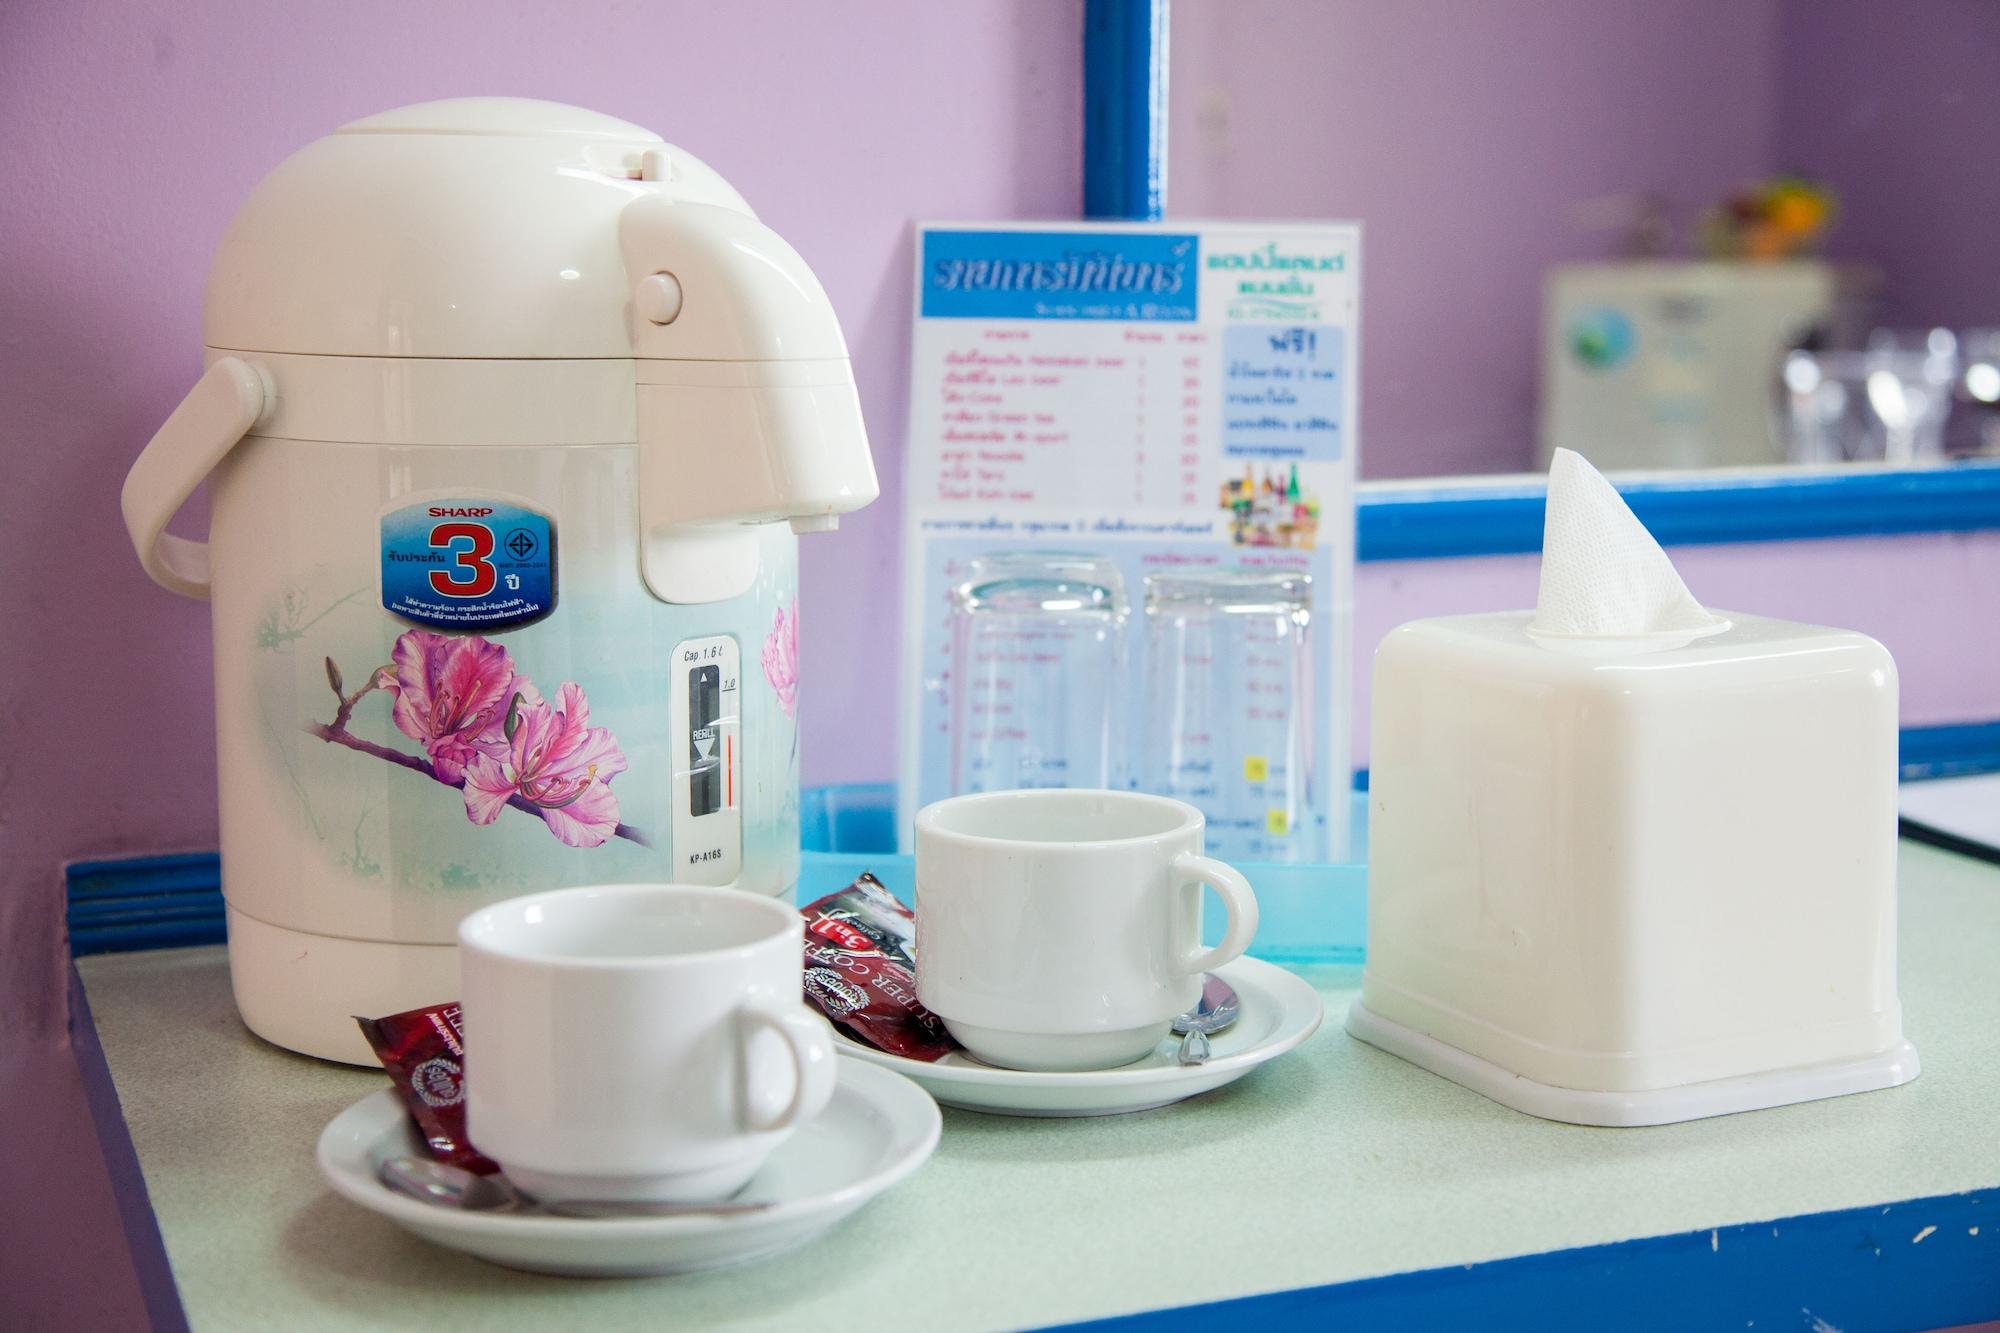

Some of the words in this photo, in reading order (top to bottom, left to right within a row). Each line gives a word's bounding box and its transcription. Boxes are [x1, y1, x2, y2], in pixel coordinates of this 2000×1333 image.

[428, 507, 493, 518] SHARP
[428, 521, 498, 599] 3
[504, 573, 520, 590] ปี
[724, 678, 736, 689] 1.0
[690, 848, 722, 865] KP-A16S
[872, 972, 939, 1030] SUPER
